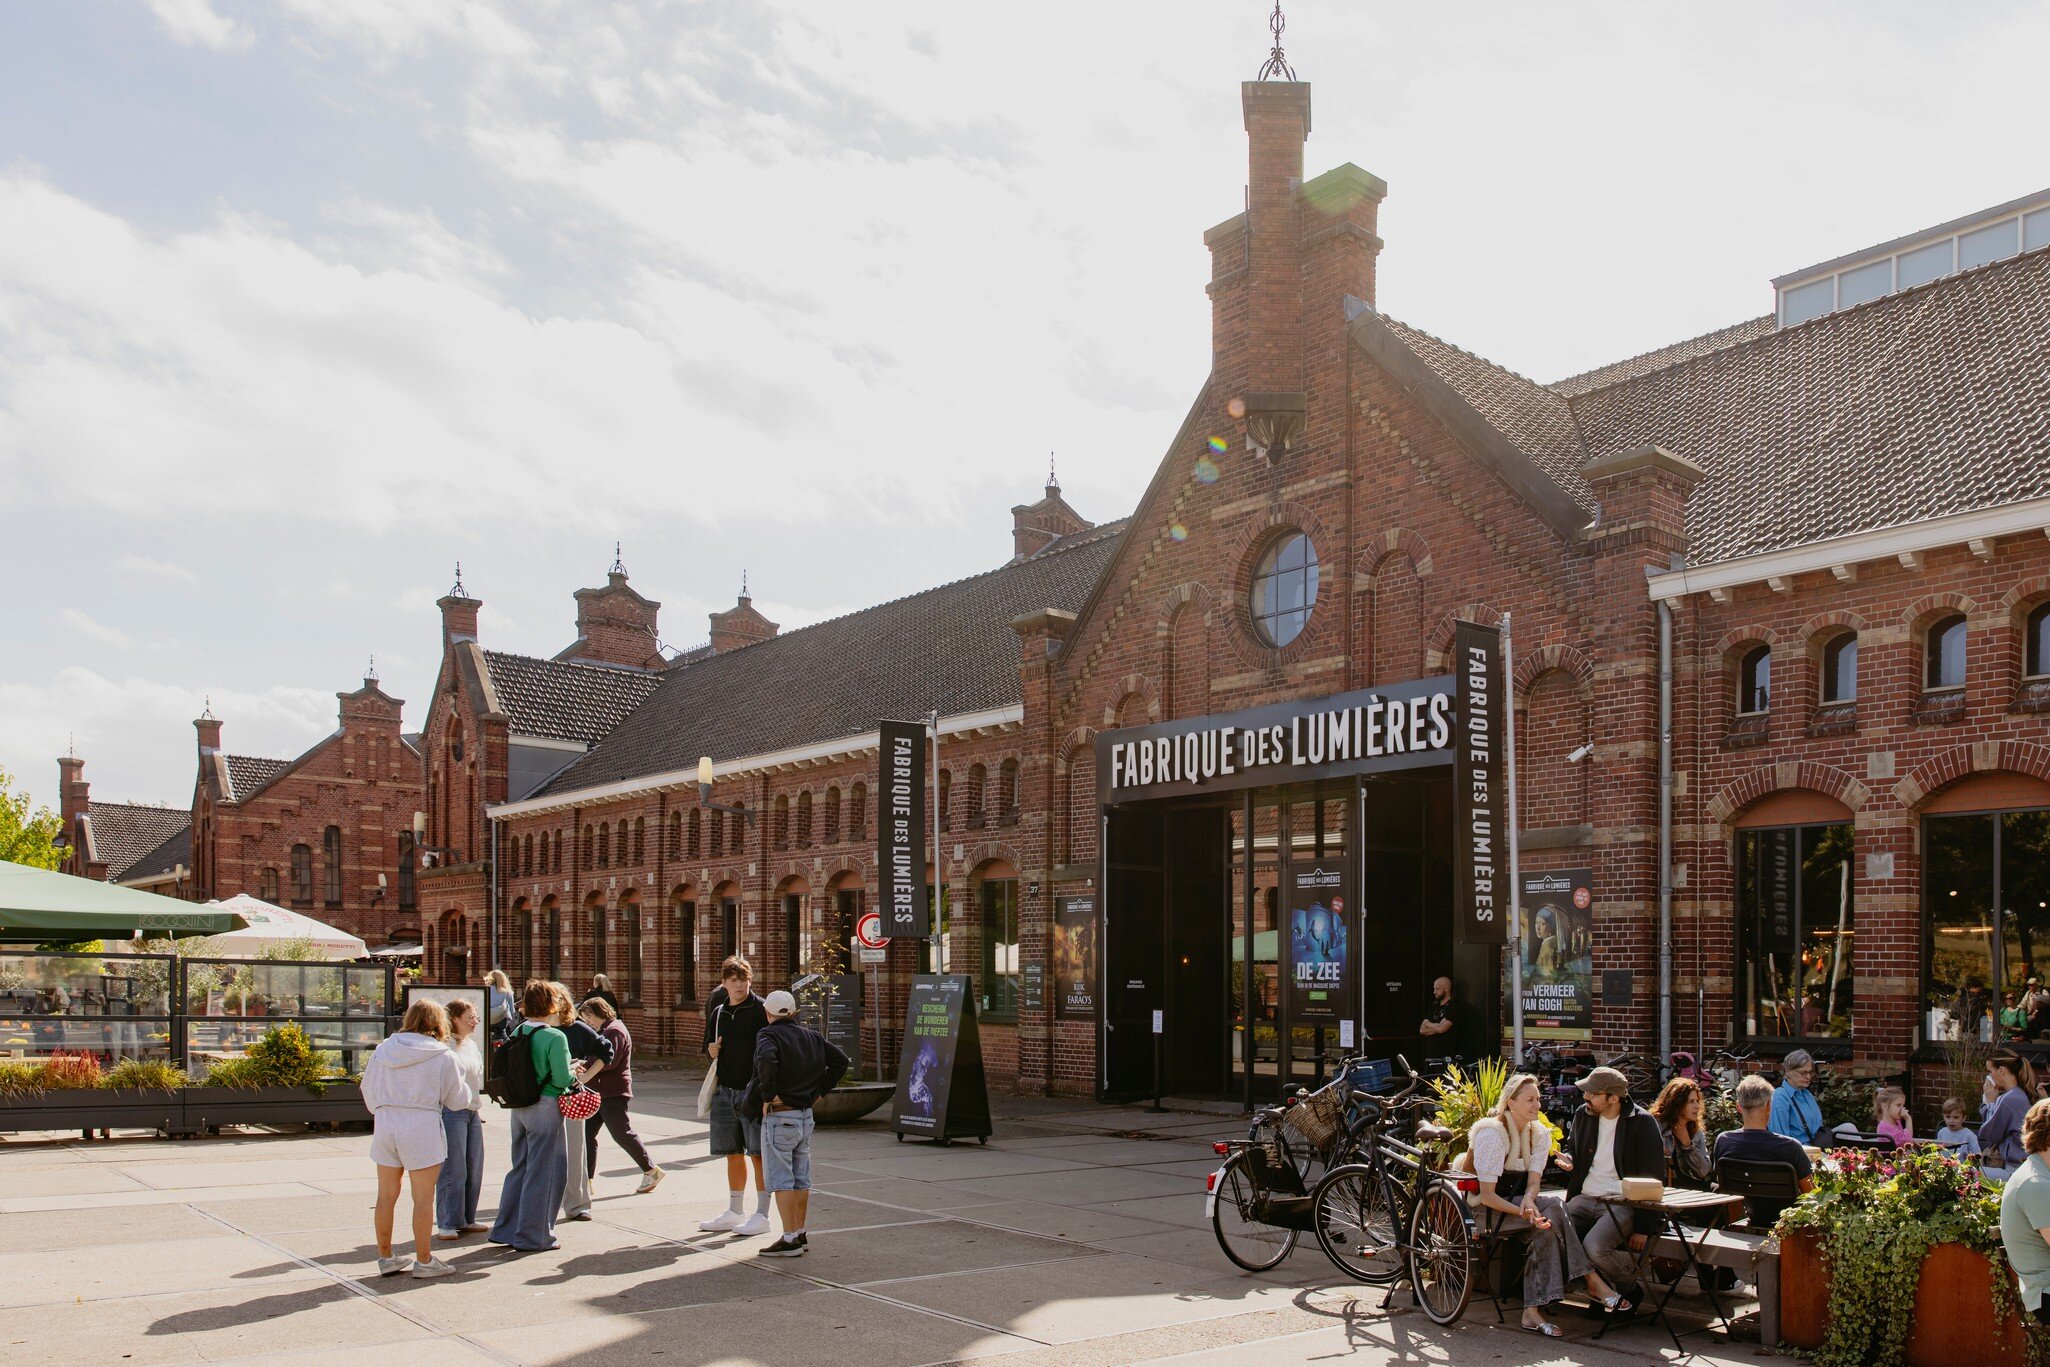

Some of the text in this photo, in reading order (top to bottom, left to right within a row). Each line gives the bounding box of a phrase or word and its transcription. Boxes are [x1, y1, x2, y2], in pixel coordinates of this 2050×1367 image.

[1111, 692, 1449, 788] FABRIQUE DES LUMIÈRES
[1468, 647, 1495, 922] FABRIQUE DES LUMIÈRES
[891, 737, 915, 923] FABRIQUE DES LUMIÈRES
[1297, 962, 1340, 980] DE ZEE
[1533, 984, 1575, 997] VERMEER
[1067, 995, 1092, 1005] FARAO'S
[1538, 998, 1562, 1011] GOGH
[917, 1015, 923, 1024] DE
[914, 1026, 922, 1035] VAN
[923, 1026, 929, 1035] DE
